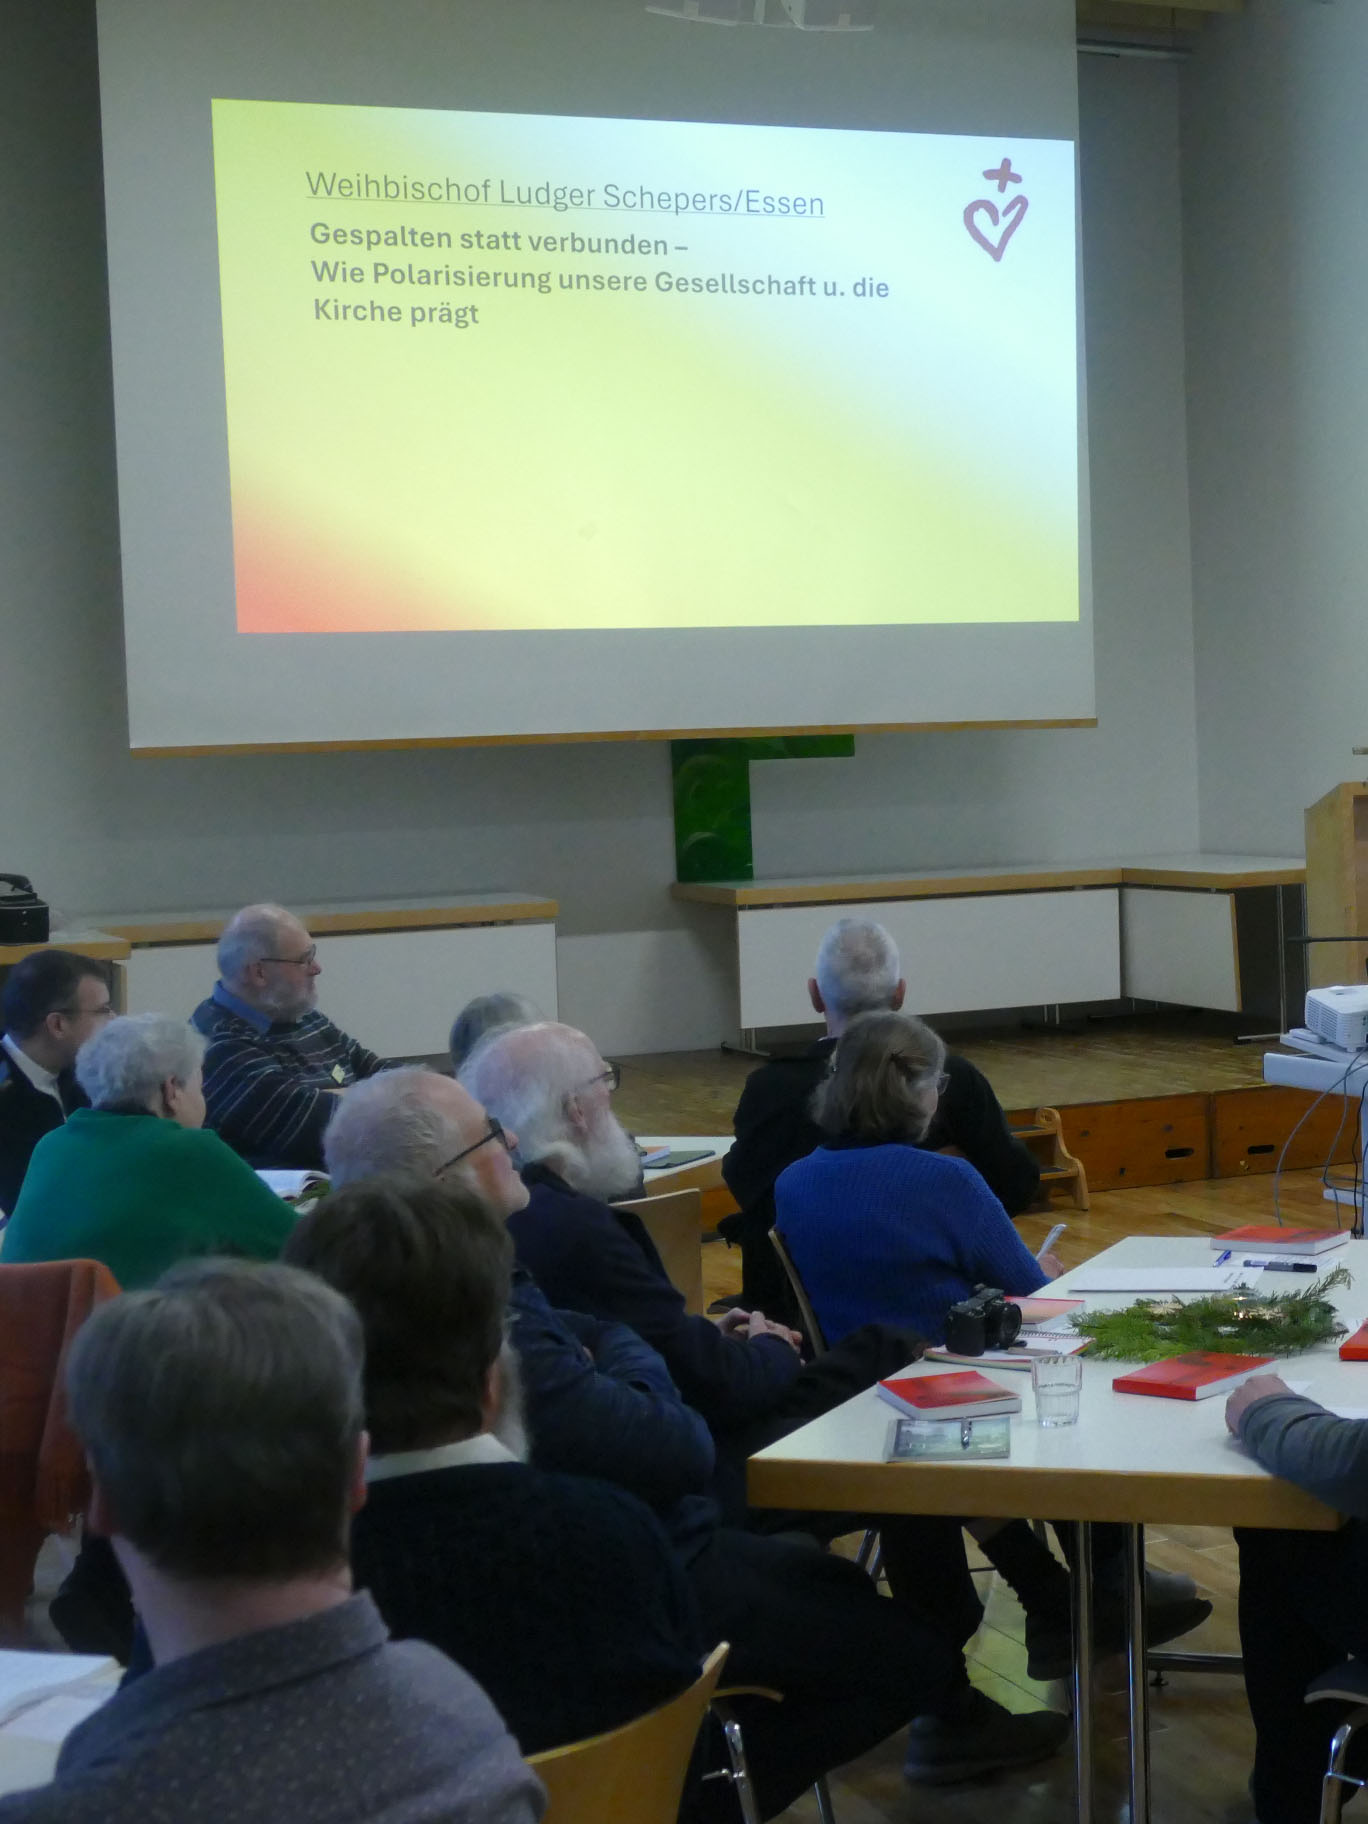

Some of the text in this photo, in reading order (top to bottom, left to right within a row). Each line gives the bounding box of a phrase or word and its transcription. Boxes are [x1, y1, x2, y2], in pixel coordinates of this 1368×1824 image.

[305, 170, 825, 216] Weihbischof Ludger Schepers/Essen
[310, 222, 452, 252] Gespalten
[460, 229, 522, 251] statt
[528, 231, 669, 256] verbunden
[311, 260, 890, 298] Wie Polarisierung unsere Gesellschaft u. die
[314, 298, 480, 329] Kirche prägt
